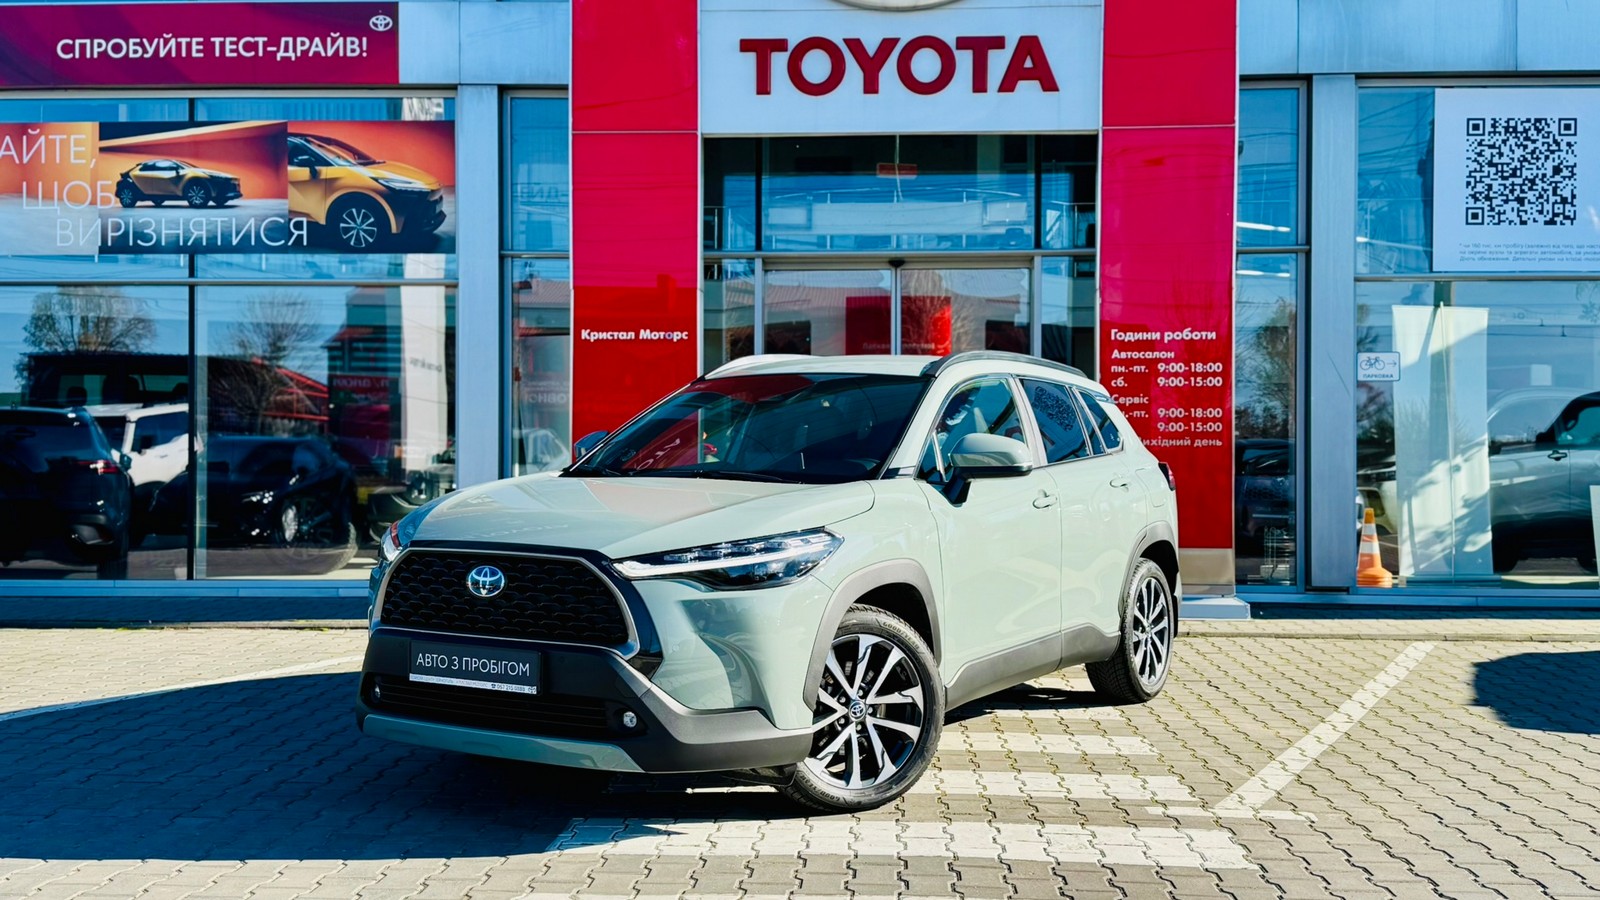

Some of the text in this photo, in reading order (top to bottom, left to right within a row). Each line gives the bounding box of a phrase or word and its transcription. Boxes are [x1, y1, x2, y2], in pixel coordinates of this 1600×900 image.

[56, 32, 368, 61] СПРОБУЙТЕ ТЕСТ-ДРАЙВ!
[739, 35, 1060, 96] TOYOTA
[22, 180, 115, 216] ЩОБ
[56, 217, 308, 248] ВИРІЗНЯТИСЯ
[581, 328, 689, 342] Кристал Моторс
[1110, 328, 1216, 344] Години роботи
[1111, 349, 1175, 359] Автосалон
[1111, 362, 1223, 373] пн.-пт. 9:00-18:00
[1111, 376, 1223, 387] сб. 9:00-15:00
[1111, 393, 1149, 407] Сервіс
[1157, 407, 1223, 419] 9:00-18:00
[1157, 421, 1223, 432] 9:00-15:00
[1141, 435, 1223, 447] ихідний день
[416, 653, 530, 677] АВТО З ПРОБІГОМ
